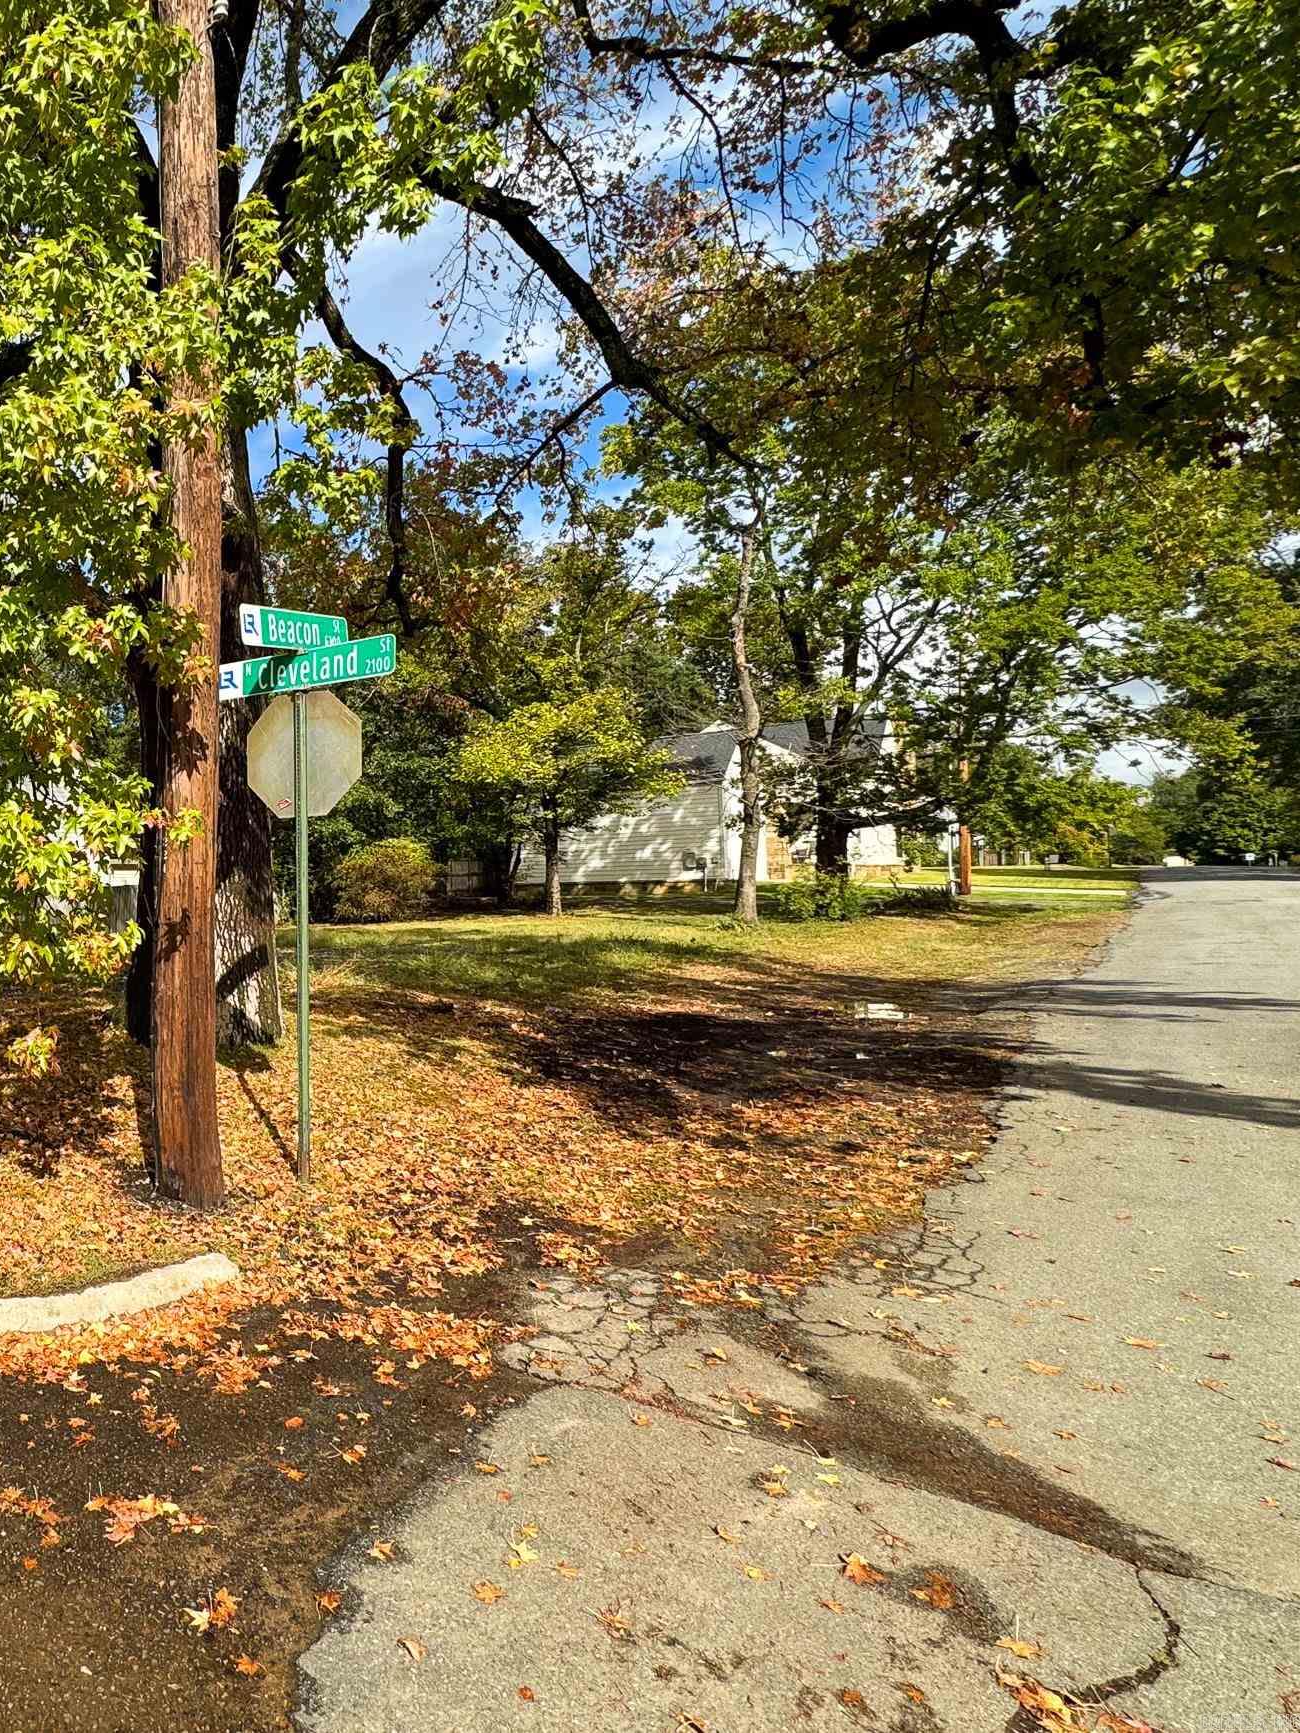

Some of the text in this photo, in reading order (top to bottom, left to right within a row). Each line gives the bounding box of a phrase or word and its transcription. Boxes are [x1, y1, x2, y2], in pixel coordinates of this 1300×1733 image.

[267, 614, 320, 646] Beacon
[258, 645, 358, 690] Cleveland
[380, 638, 391, 653] St
[365, 656, 390, 674] 2100
